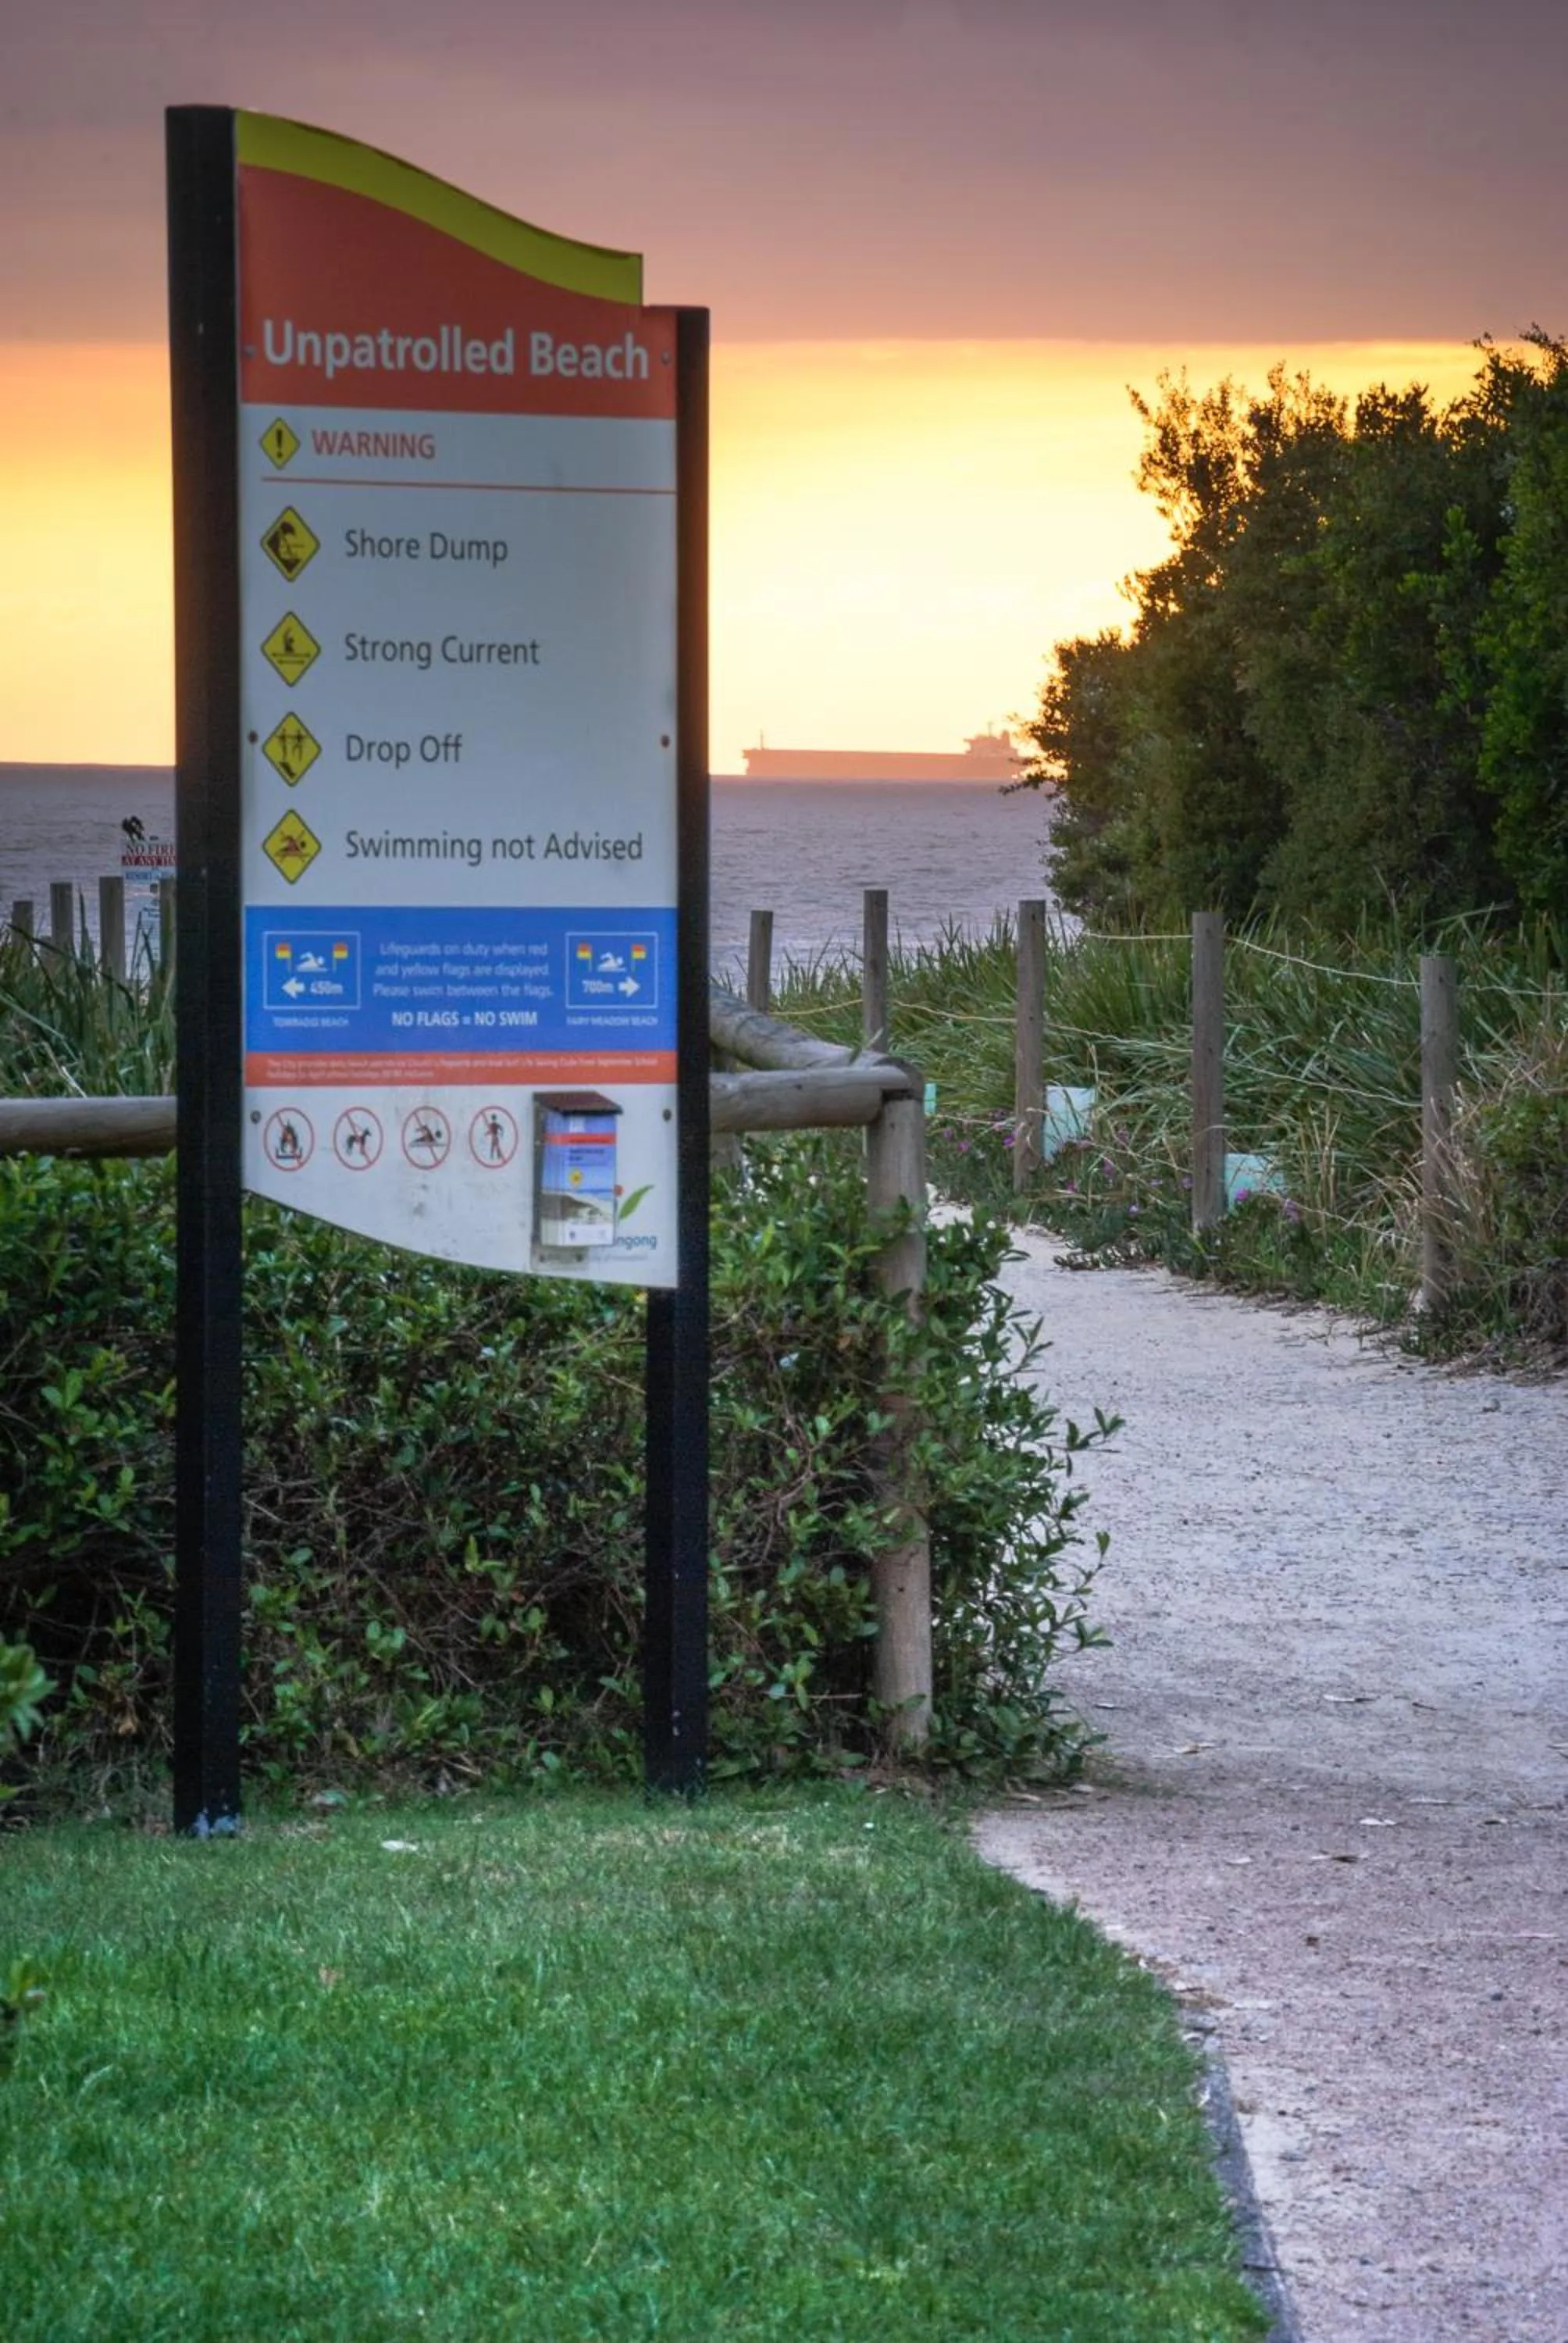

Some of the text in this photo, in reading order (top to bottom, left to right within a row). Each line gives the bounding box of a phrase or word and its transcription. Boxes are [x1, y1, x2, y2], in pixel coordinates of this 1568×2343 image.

[263, 318, 649, 379] Unpatrolled Beach
[312, 429, 436, 459] WARNING
[344, 528, 508, 569] Shore Dump
[344, 633, 540, 670] Strong Current
[346, 733, 462, 769] Drop Off
[346, 829, 643, 867] Swimming not Advised
[380, 943, 548, 958] Lifeguards on duty when red
[375, 963, 398, 975] and
[401, 963, 440, 978] yellow
[443, 963, 471, 978] flags
[472, 966, 493, 975] are
[372, 982, 410, 997] Please
[412, 983, 444, 996] swim
[447, 983, 499, 997] between
[501, 983, 521, 996] the
[392, 1011, 413, 1026] NO
[417, 1011, 460, 1026] FLAGS
[474, 1011, 495, 1026] NO
[499, 1011, 538, 1026] SWIM
[616, 1236, 657, 1250] ngong
